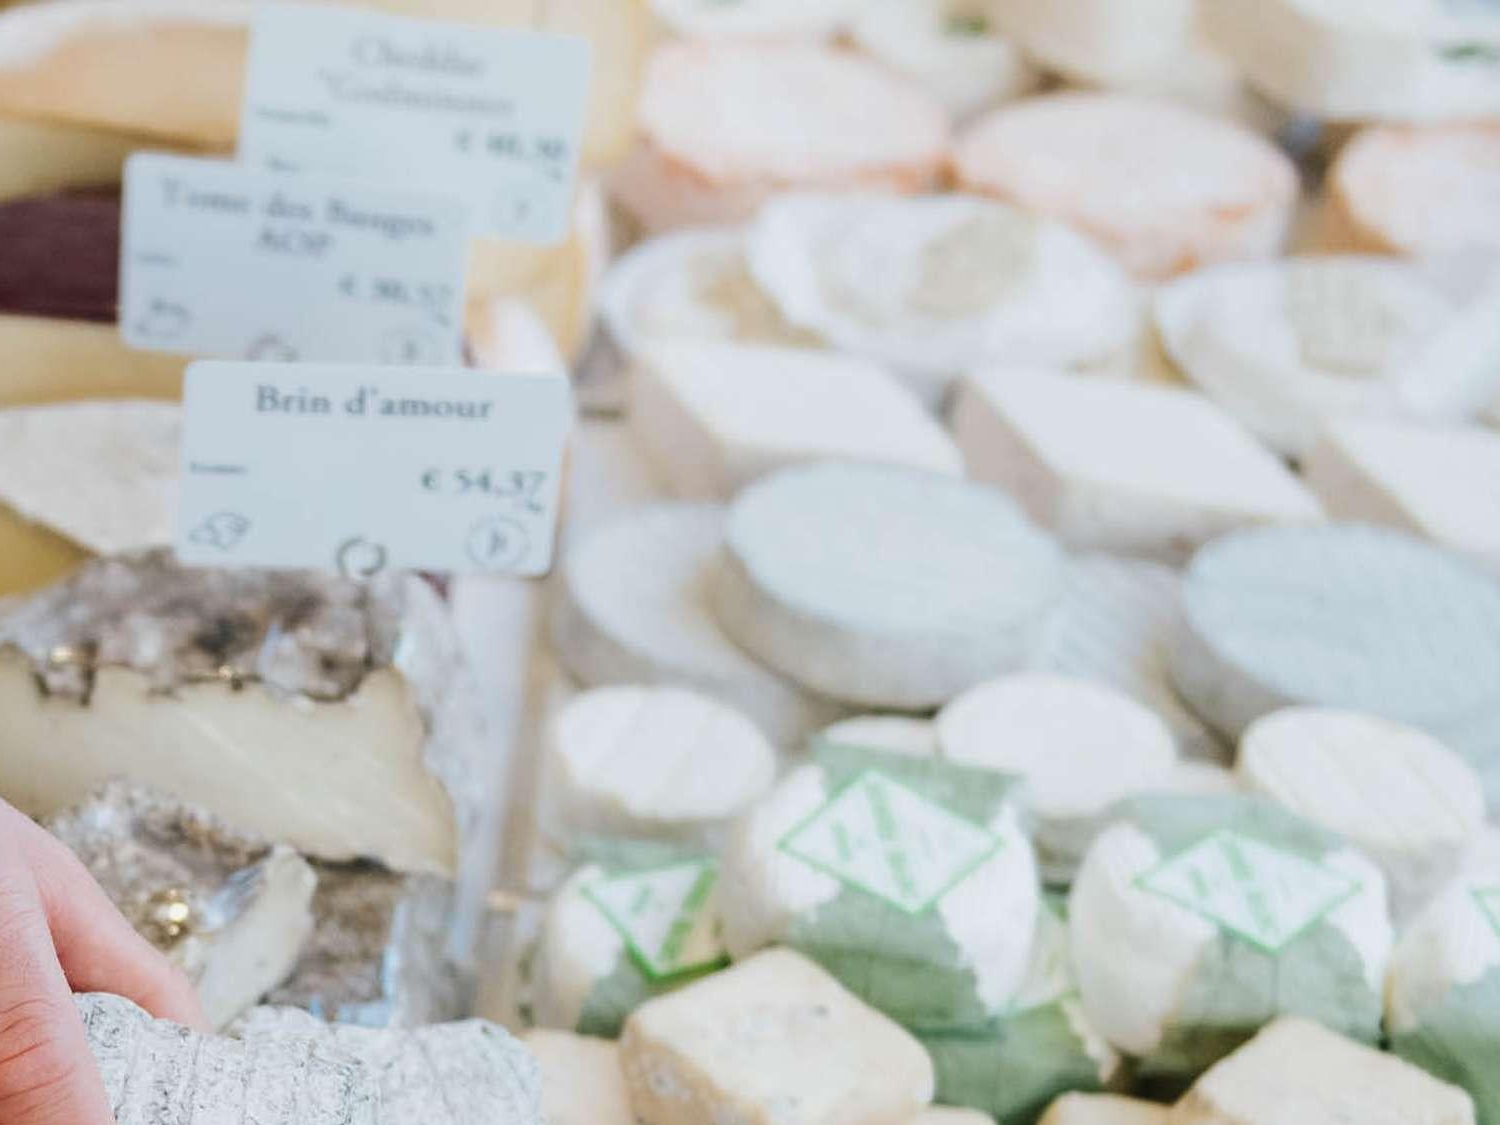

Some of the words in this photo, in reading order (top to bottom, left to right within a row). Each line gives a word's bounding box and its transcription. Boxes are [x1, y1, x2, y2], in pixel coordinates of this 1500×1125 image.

[255, 384, 332, 415] Brin
[344, 386, 493, 420] d'amour
[419, 467, 443, 491] €
